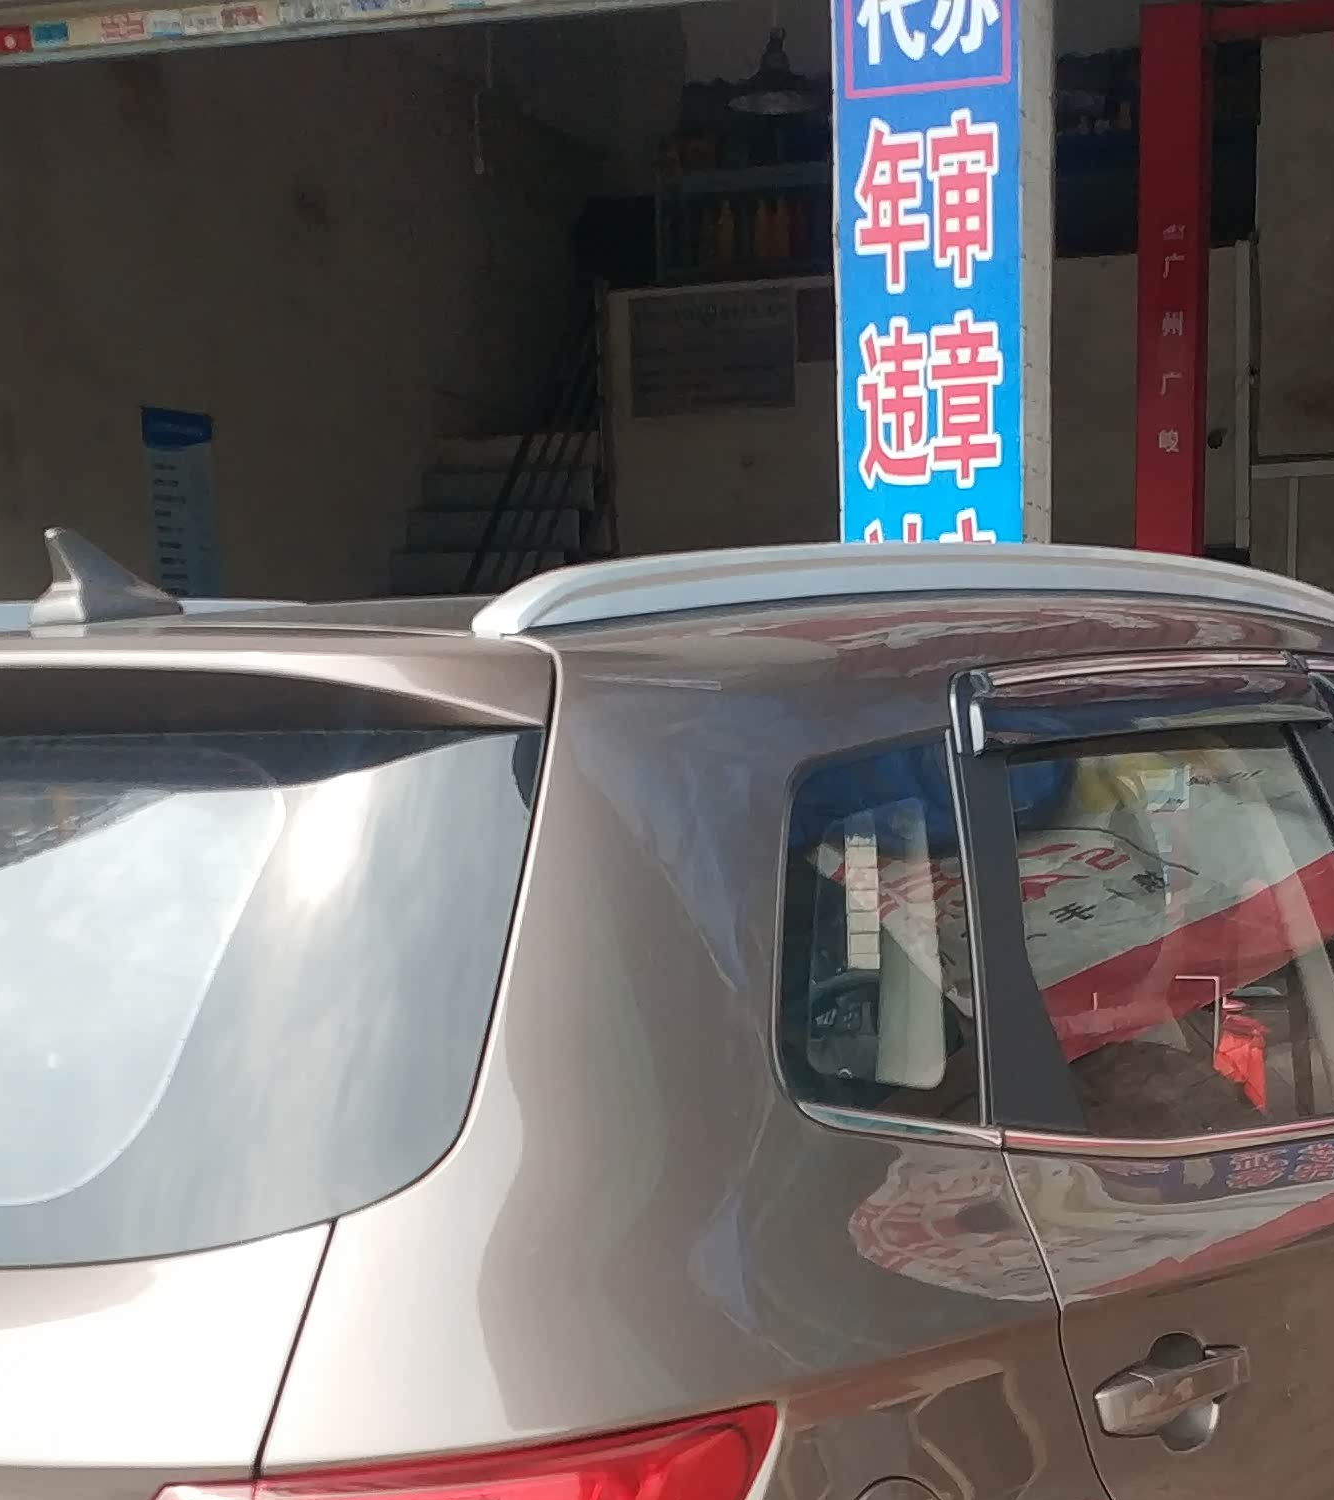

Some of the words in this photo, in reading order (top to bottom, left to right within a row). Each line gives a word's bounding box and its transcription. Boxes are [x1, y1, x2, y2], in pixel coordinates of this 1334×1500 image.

[856, 0, 1001, 64] 代办
[854, 109, 1000, 294] 年审
[858, 310, 1003, 489] 违章
